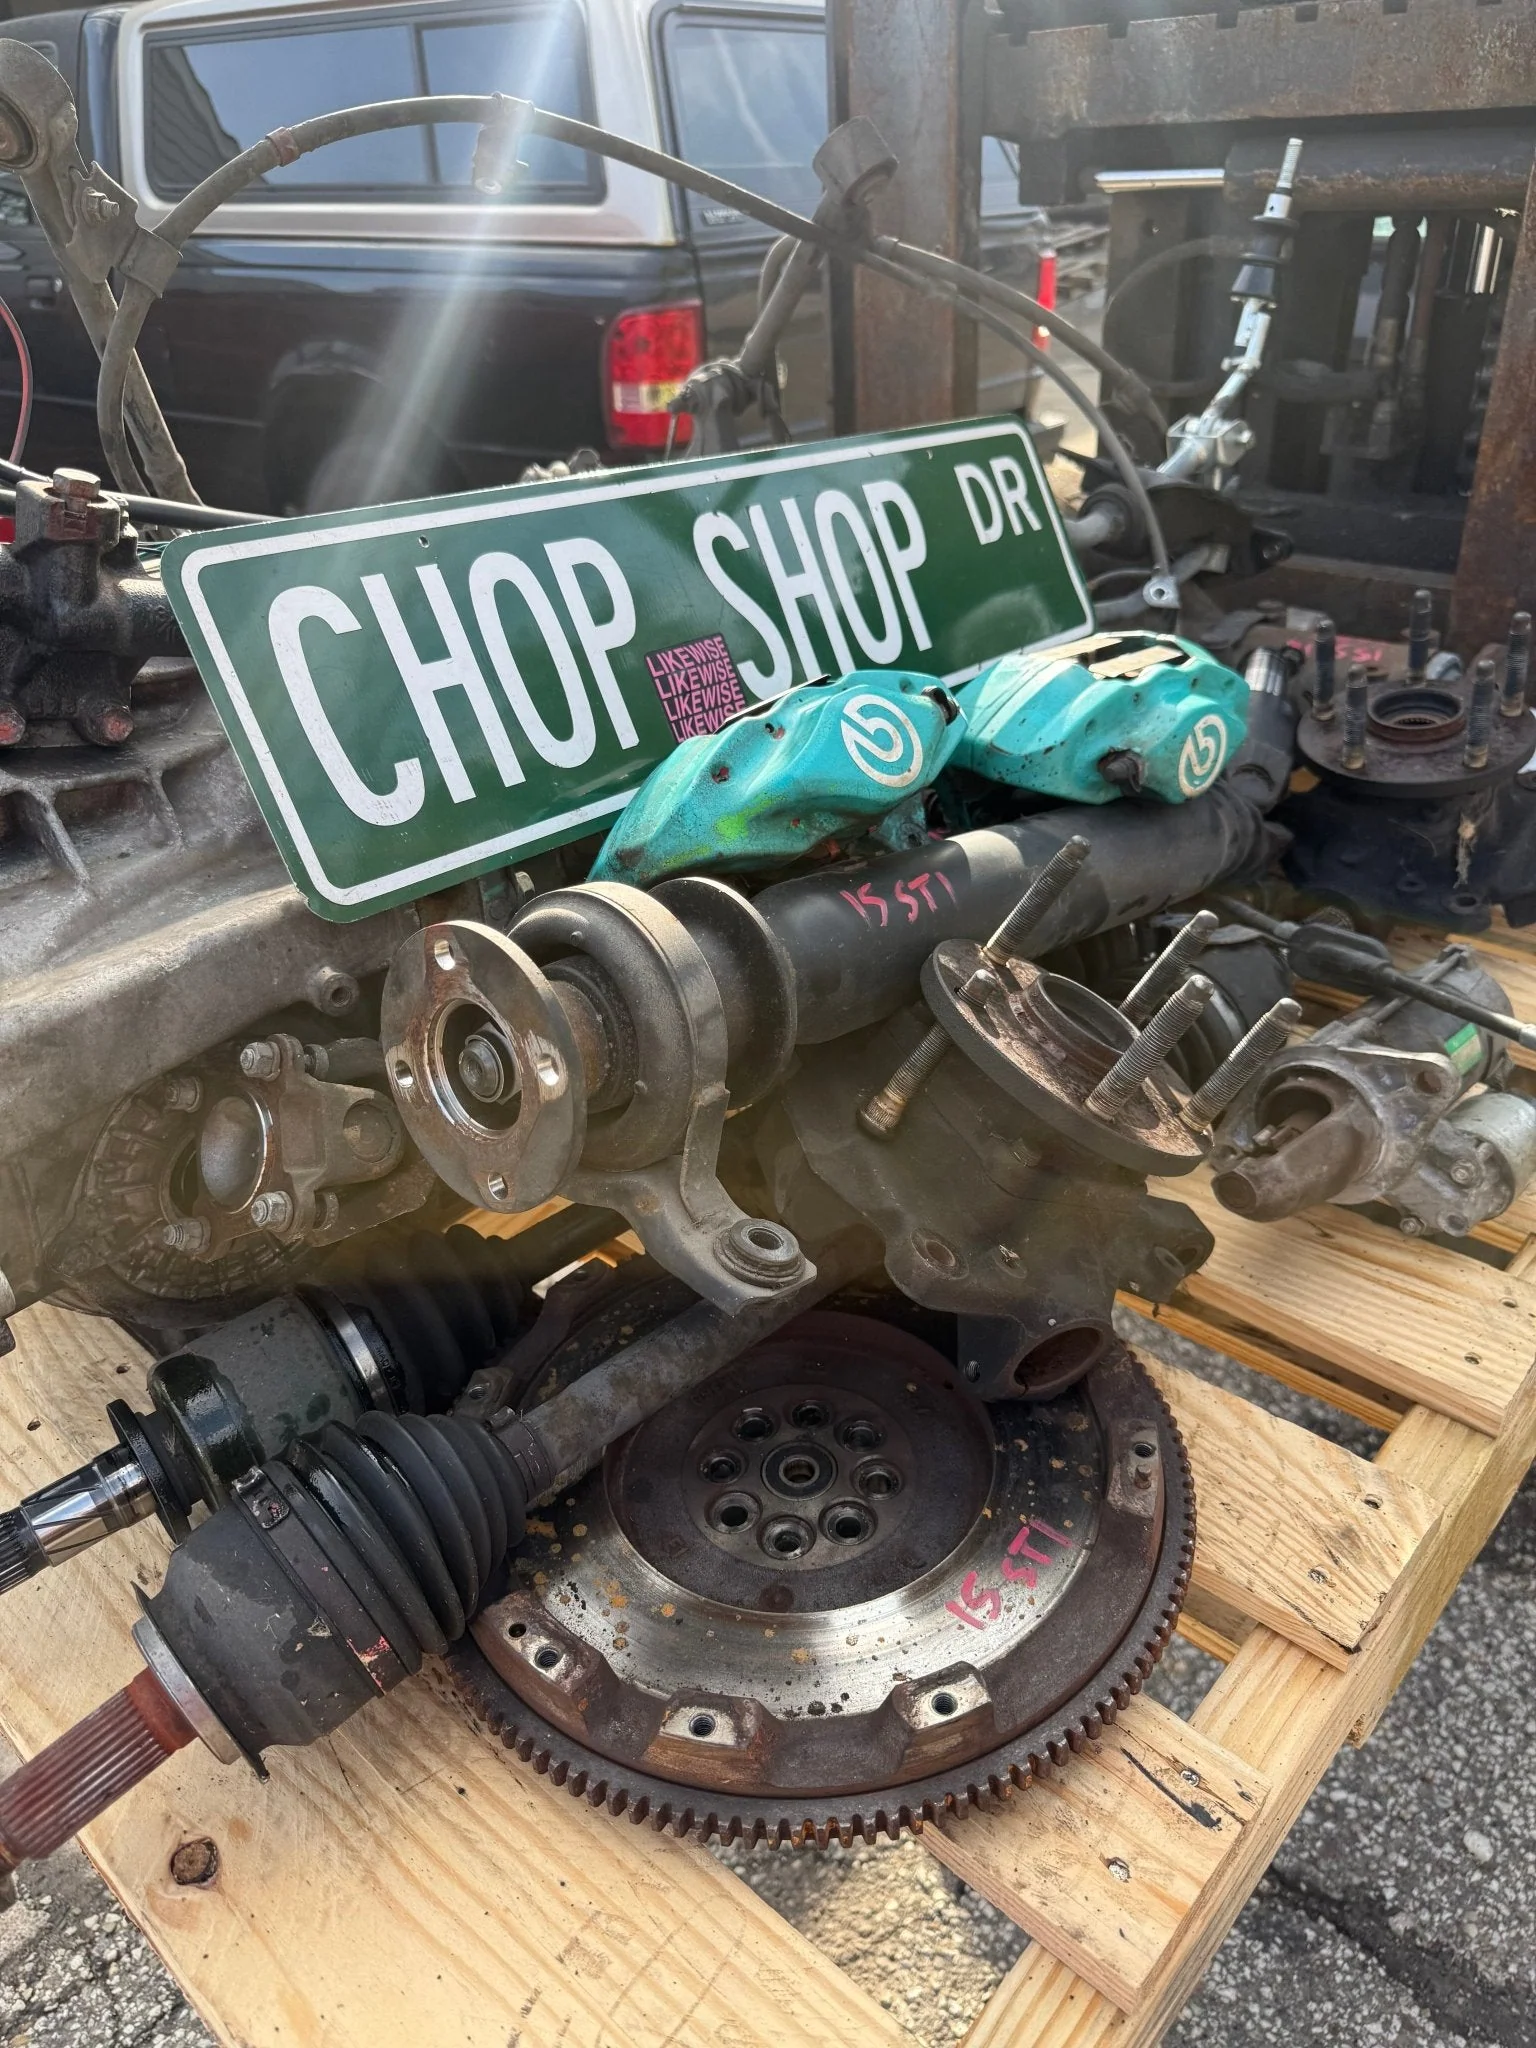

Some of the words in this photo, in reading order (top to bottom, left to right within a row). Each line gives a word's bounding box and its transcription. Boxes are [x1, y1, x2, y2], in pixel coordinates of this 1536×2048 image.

[267, 537, 639, 827] CHOP
[693, 480, 932, 701] SHOP
[954, 456, 1042, 545] DR
[646, 637, 728, 677] LIKEWISE
[655, 658, 736, 700] LIKEWISE
[663, 680, 744, 721] LIKEWISE
[840, 882, 888, 928] 15
[894, 871, 957, 924] STI
[945, 1570, 1001, 1630] 15
[1002, 1518, 1073, 1589] STI
